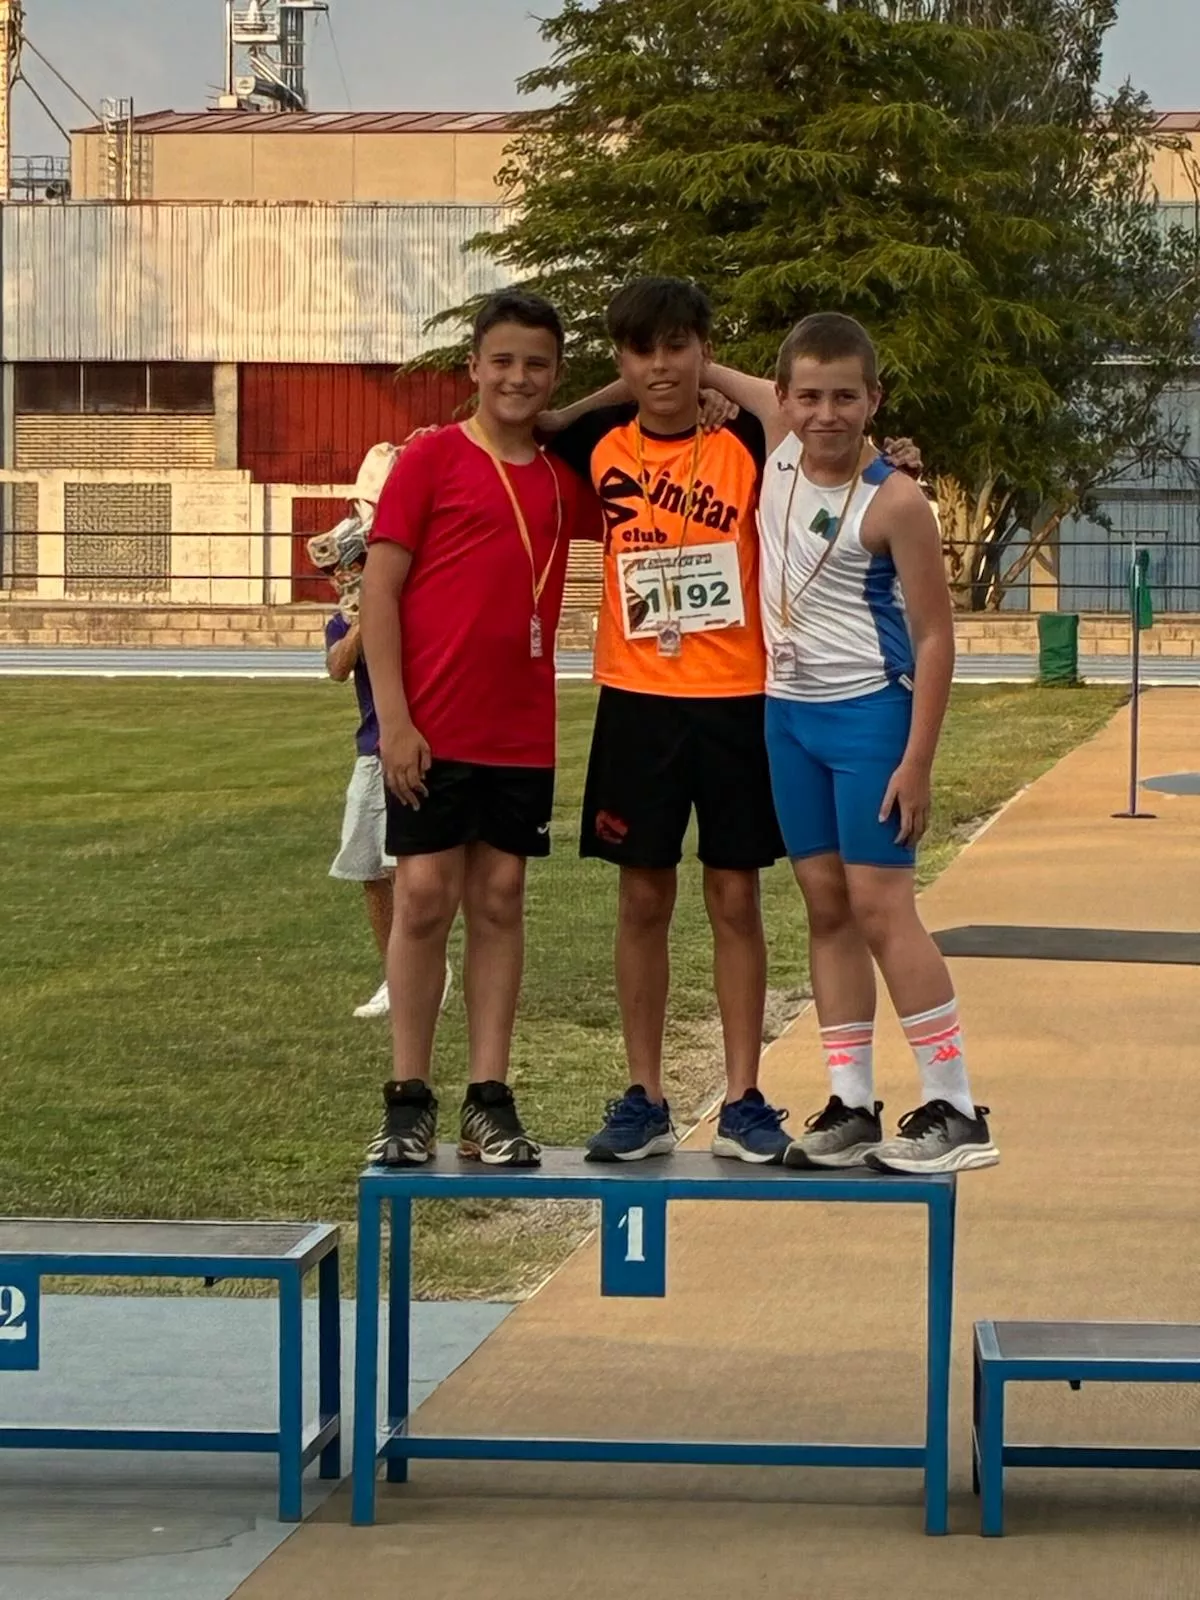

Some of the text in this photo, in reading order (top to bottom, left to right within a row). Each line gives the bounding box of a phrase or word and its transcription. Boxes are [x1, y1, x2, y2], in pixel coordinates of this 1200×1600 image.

[622, 527, 667, 544] club
[644, 581, 731, 614] 1192
[617, 1206, 646, 1262] 1
[0, 1285, 27, 1340] 2
